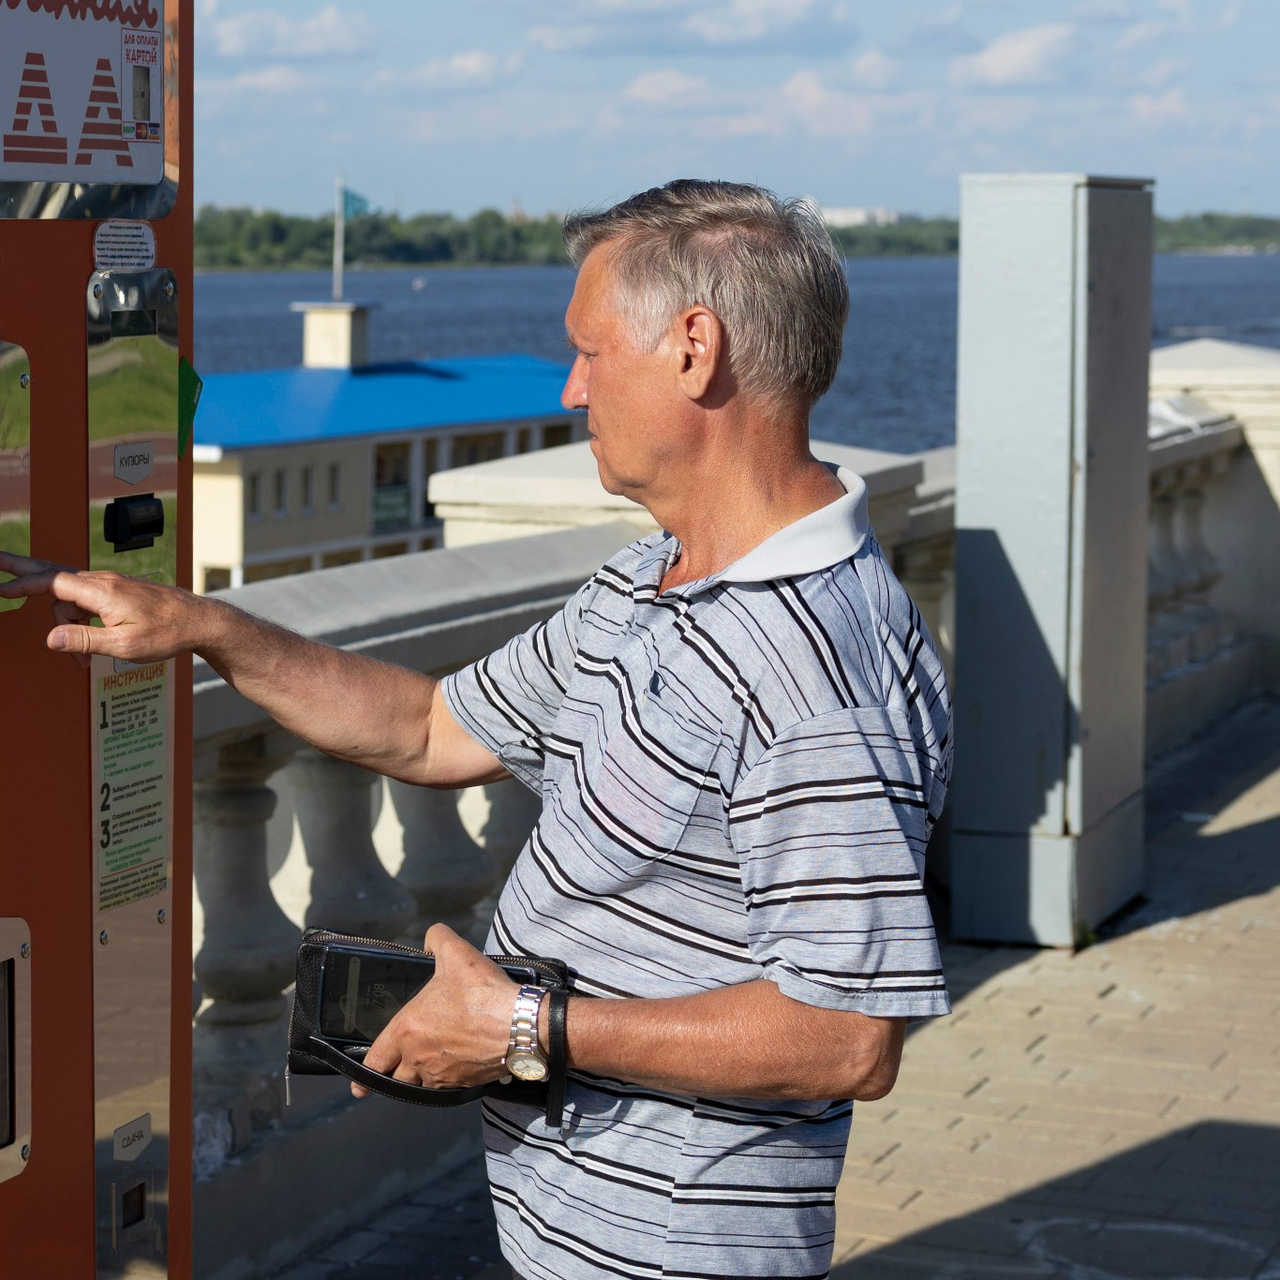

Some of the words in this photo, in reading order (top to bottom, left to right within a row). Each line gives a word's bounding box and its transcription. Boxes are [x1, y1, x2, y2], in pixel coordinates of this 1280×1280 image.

[124, 34, 135, 45] ДЛЯ
[136, 34, 158, 46] ОПЛАТЫ
[125, 47, 157, 63] КАРТОЙ
[120, 454, 149, 467] КУПЮРЫ
[103, 663, 164, 691] ИНСТРУКЦИЯ
[100, 701, 108, 729] 1
[100, 782, 110, 812] 2
[100, 819, 110, 849] 3
[122, 1129, 144, 1148] СДАЧА
